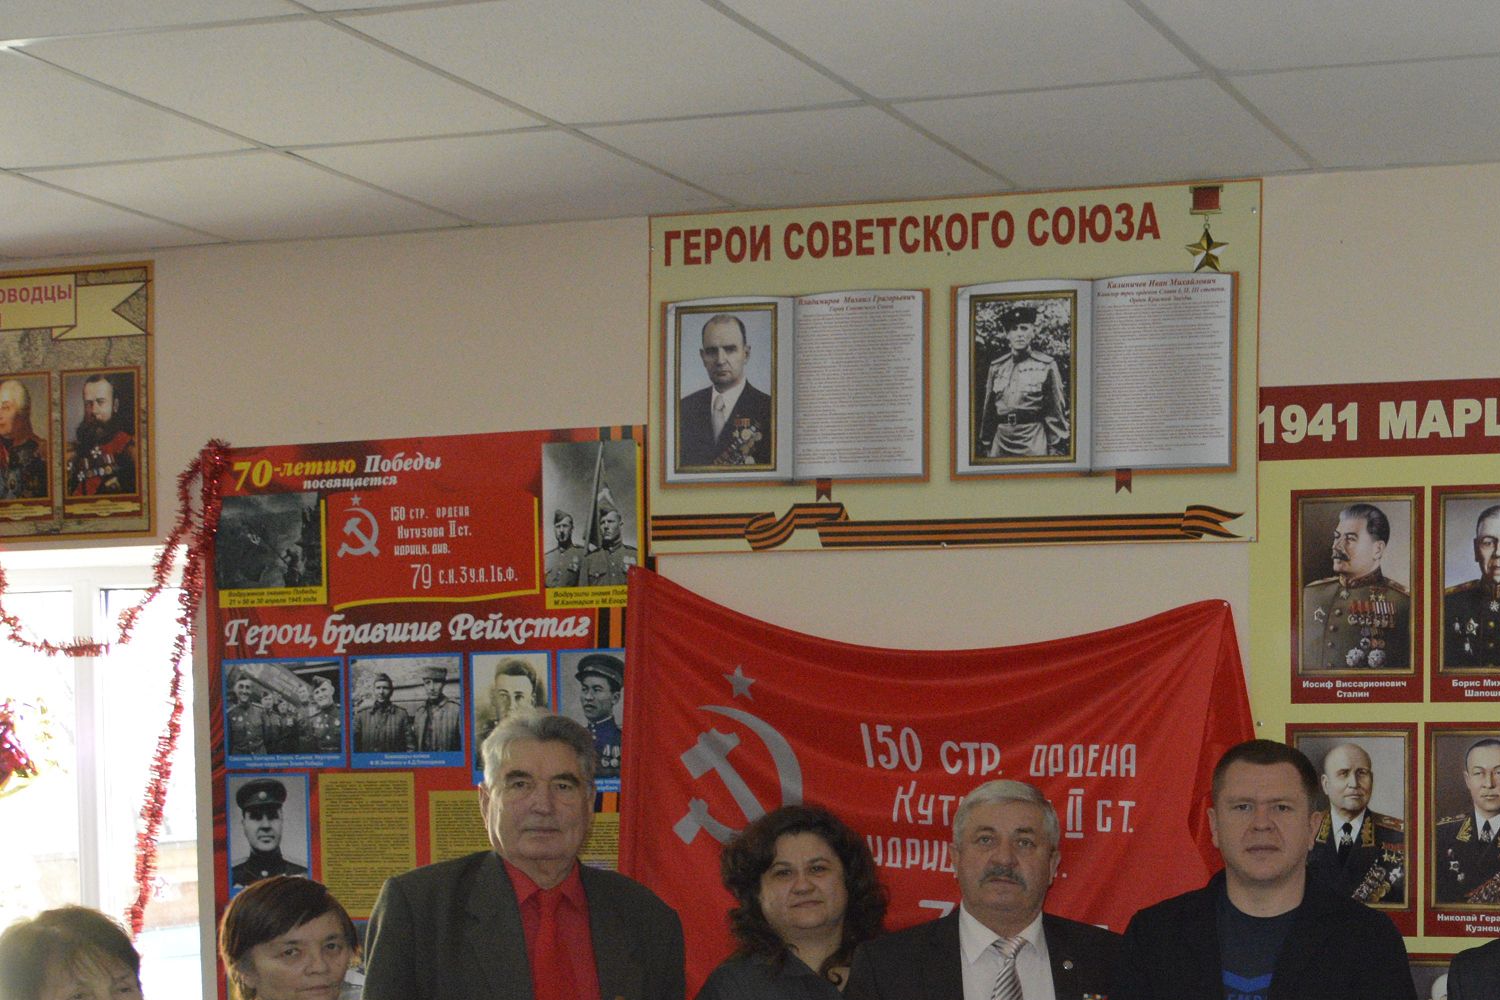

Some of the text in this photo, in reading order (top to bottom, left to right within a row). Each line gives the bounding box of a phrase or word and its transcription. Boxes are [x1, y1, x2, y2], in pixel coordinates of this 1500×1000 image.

[664, 201, 1161, 267] ГЕРОИ СОВЕТСКОГО СОЮЗА
[1259, 402, 1359, 443] 1941
[232, 451, 441, 491] 70-летию Победы
[302, 475, 398, 490] посвящается
[390, 506, 406, 521] 150
[410, 563, 432, 590] 79
[224, 612, 592, 654] Герои, бравшие Рейхстаг
[1302, 679, 1407, 689] Иосиф Виссарионович
[1336, 690, 1370, 698] Сталин
[1452, 679, 1481, 688] Борис
[860, 722, 923, 772] 150
[1437, 913, 1477, 922] Николай
